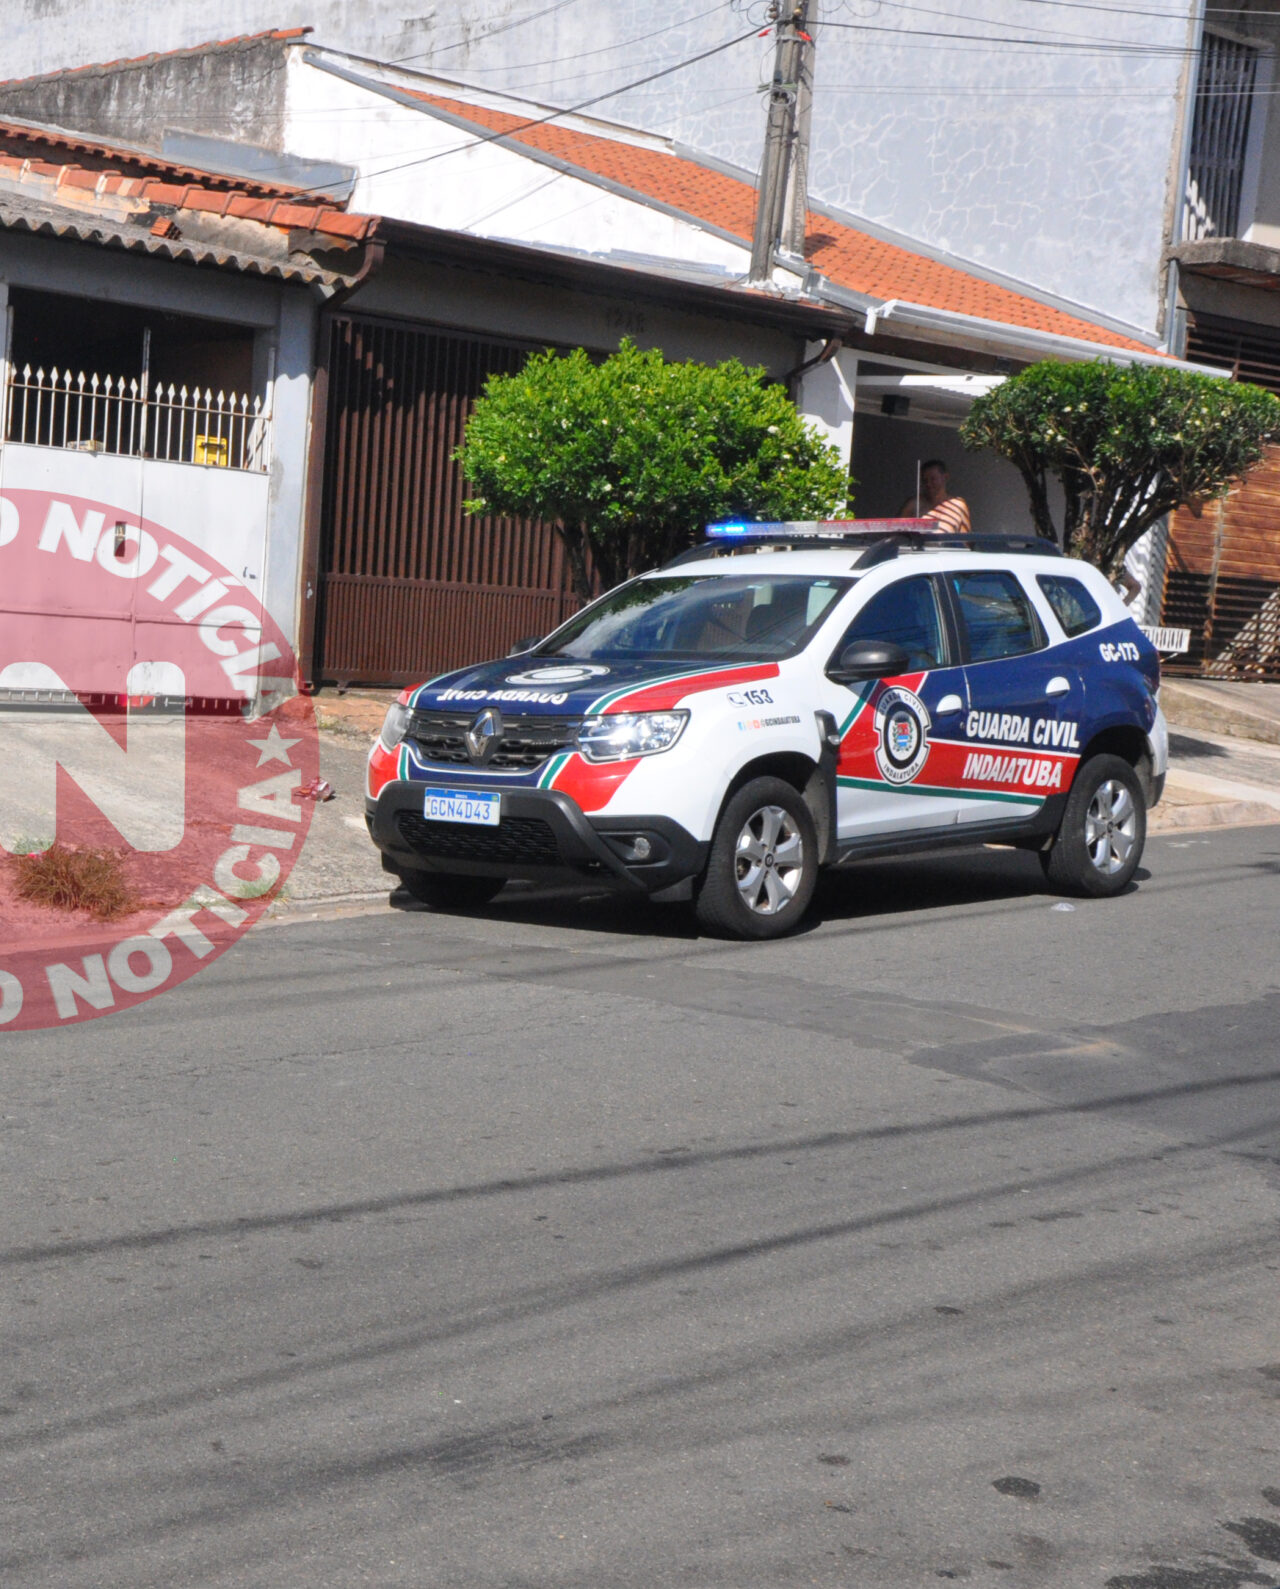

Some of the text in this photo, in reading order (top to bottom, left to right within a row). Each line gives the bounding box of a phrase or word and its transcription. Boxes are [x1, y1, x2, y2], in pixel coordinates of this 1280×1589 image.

[1099, 642, 1140, 662] GC-173
[743, 688, 774, 705] 153
[966, 710, 1081, 748] GUARDA CIVIL
[962, 752, 1063, 788] INDAIATUBA
[431, 799, 491, 821] GCN4D43
